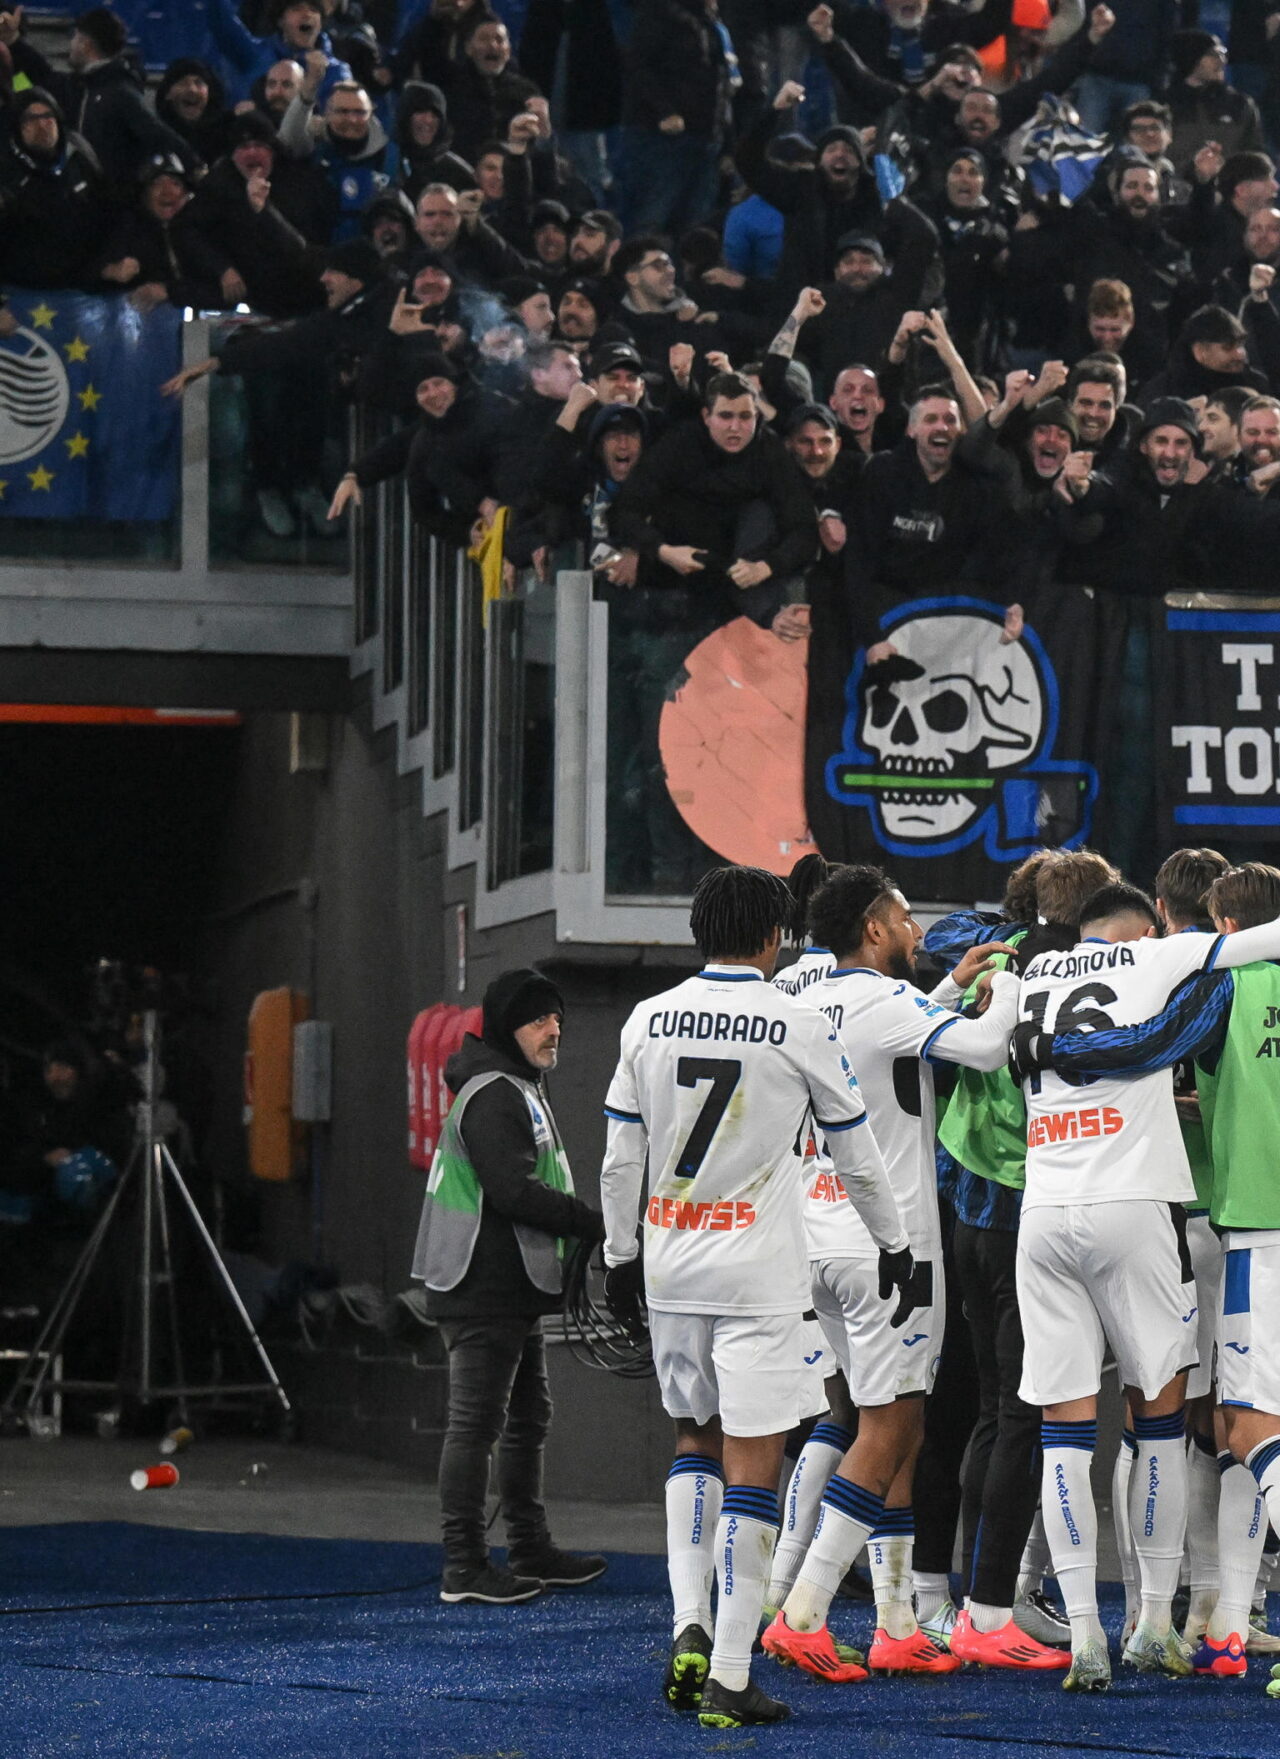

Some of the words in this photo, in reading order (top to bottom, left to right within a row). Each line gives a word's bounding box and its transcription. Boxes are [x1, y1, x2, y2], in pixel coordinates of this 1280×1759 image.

[648, 1010, 787, 1046] CUADRADO
[674, 1056, 742, 1179] 7
[1027, 1106, 1124, 1148] GEWISS
[646, 1196, 756, 1232] GEWISS
